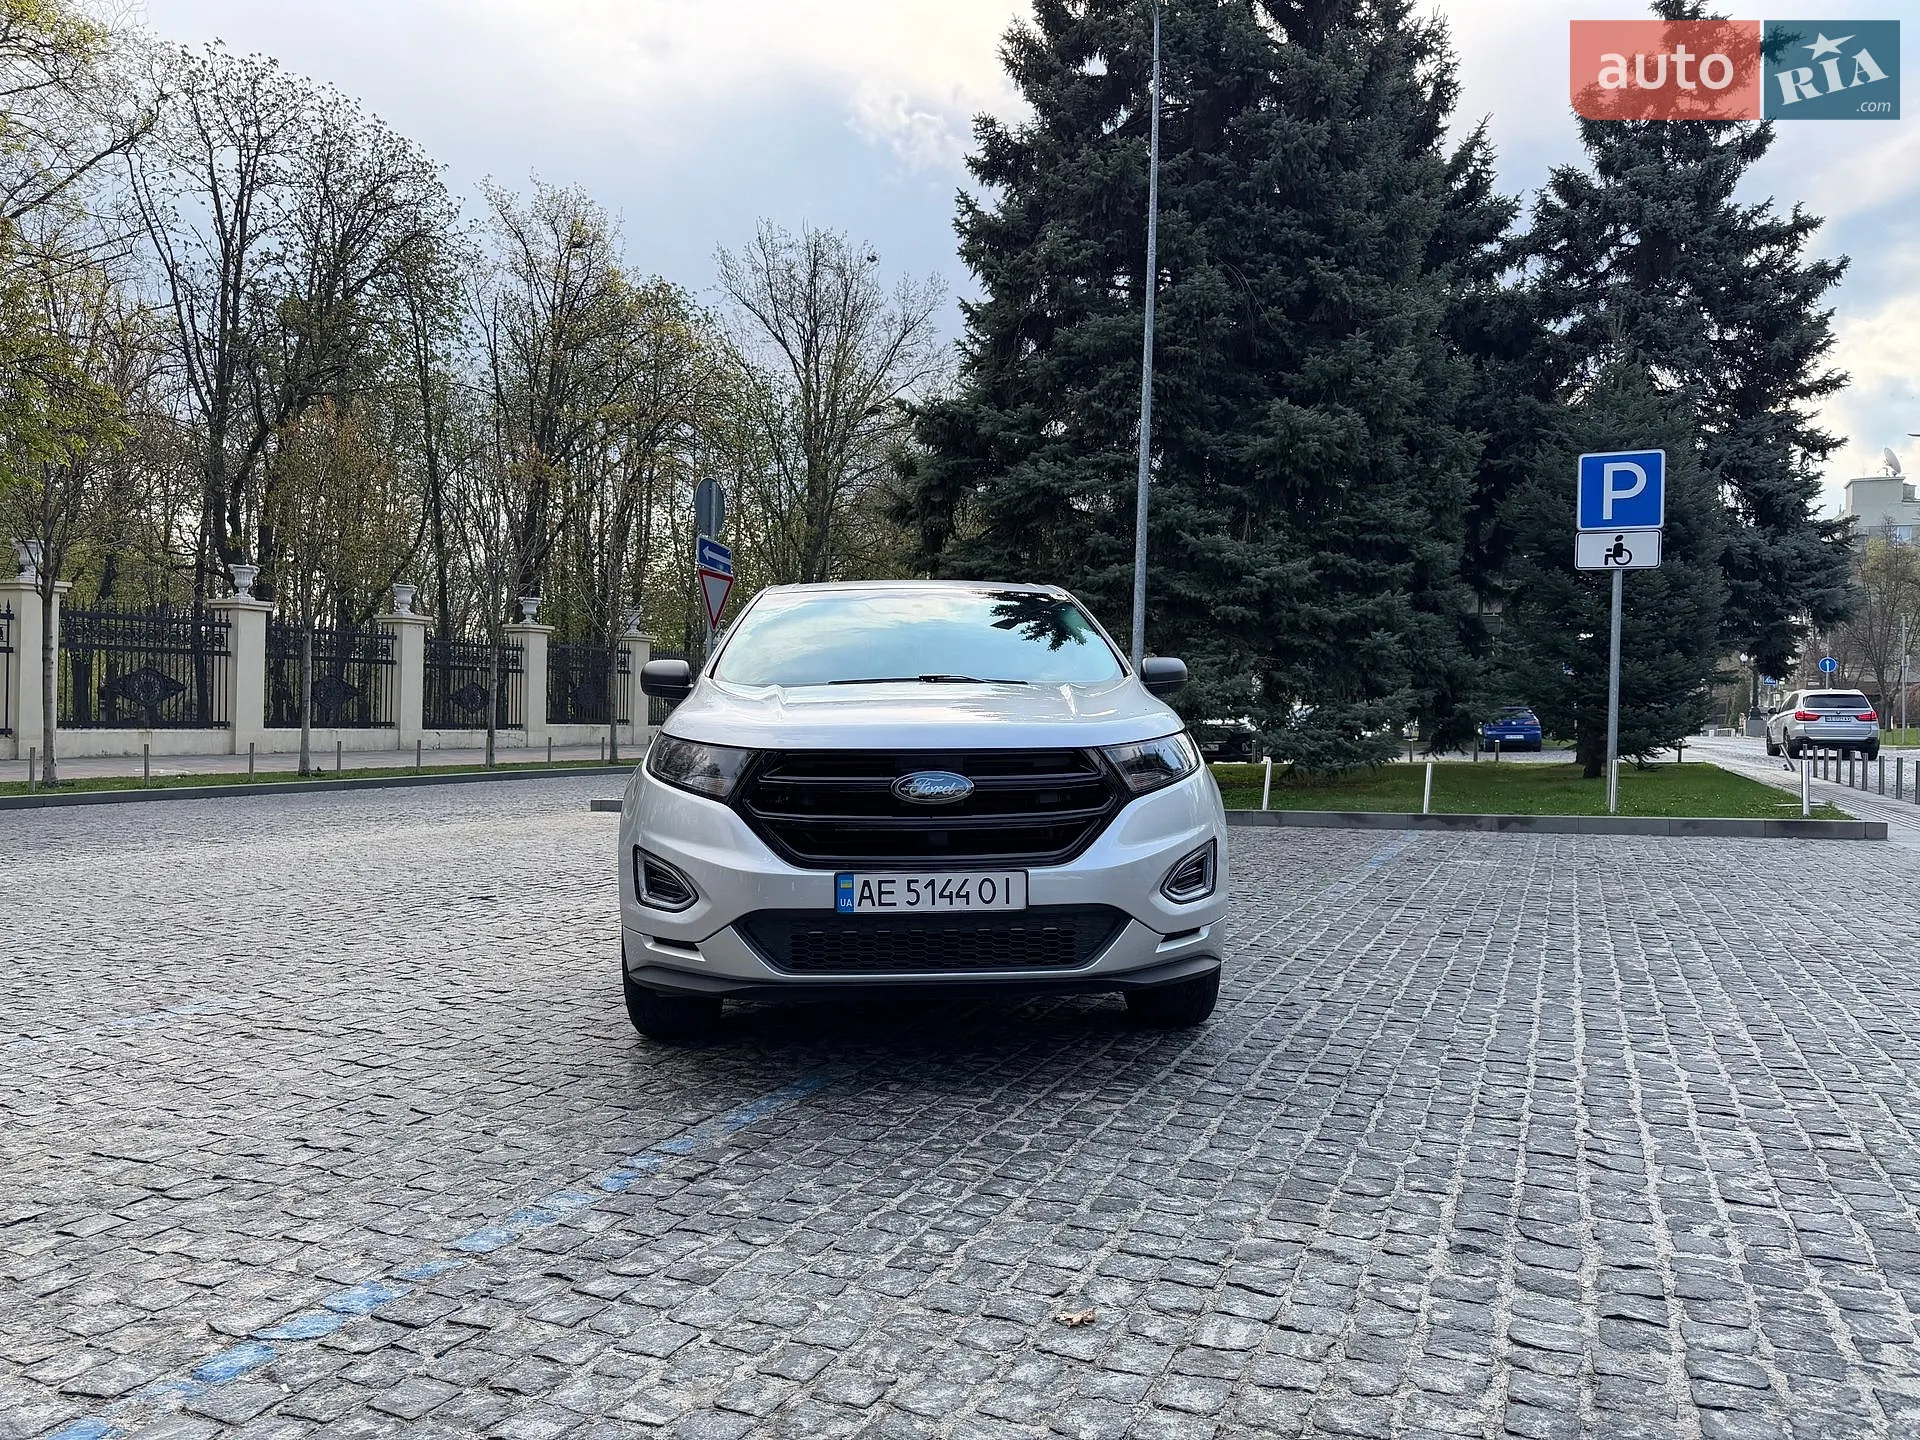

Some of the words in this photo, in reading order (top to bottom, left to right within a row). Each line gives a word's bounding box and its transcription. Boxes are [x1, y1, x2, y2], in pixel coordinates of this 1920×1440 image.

[1602, 461, 1647, 520] P
[907, 777, 958, 796] Ford
[840, 898, 853, 907] UA
[857, 879, 897, 907] AE
[905, 878, 970, 906] 5144
